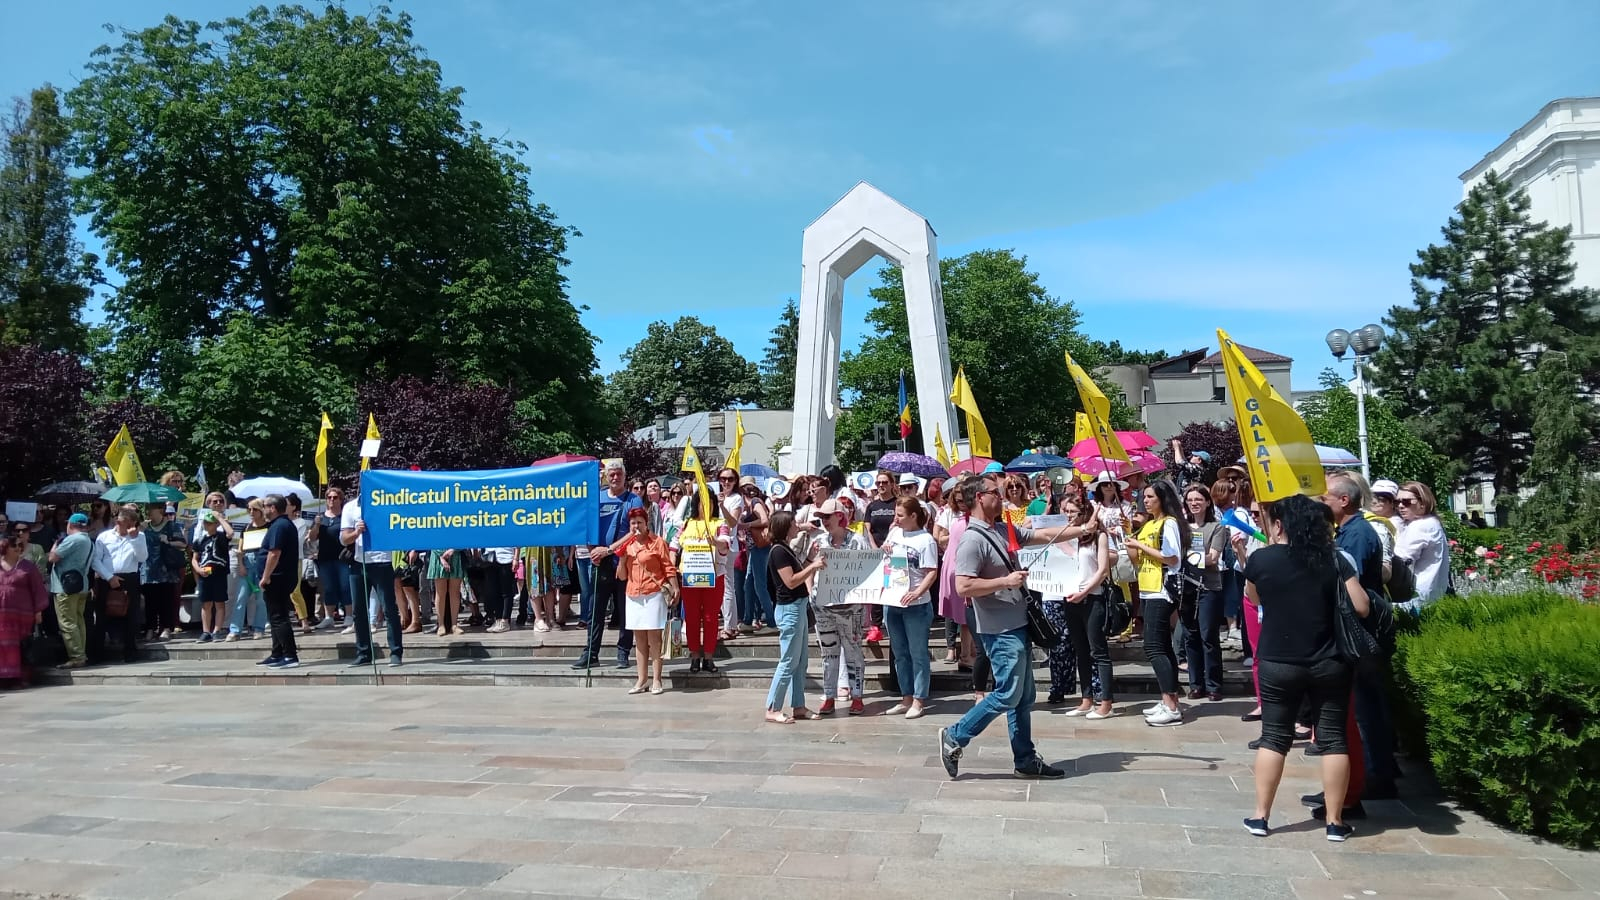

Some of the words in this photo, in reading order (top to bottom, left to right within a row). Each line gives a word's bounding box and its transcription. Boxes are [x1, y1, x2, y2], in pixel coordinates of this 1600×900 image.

[1246, 398, 1275, 493] GALAȚI
[371, 486, 450, 507] Sindicatul
[454, 481, 588, 506] Învățământului
[389, 510, 509, 530] Preuniversitar
[512, 507, 566, 529] Galați
